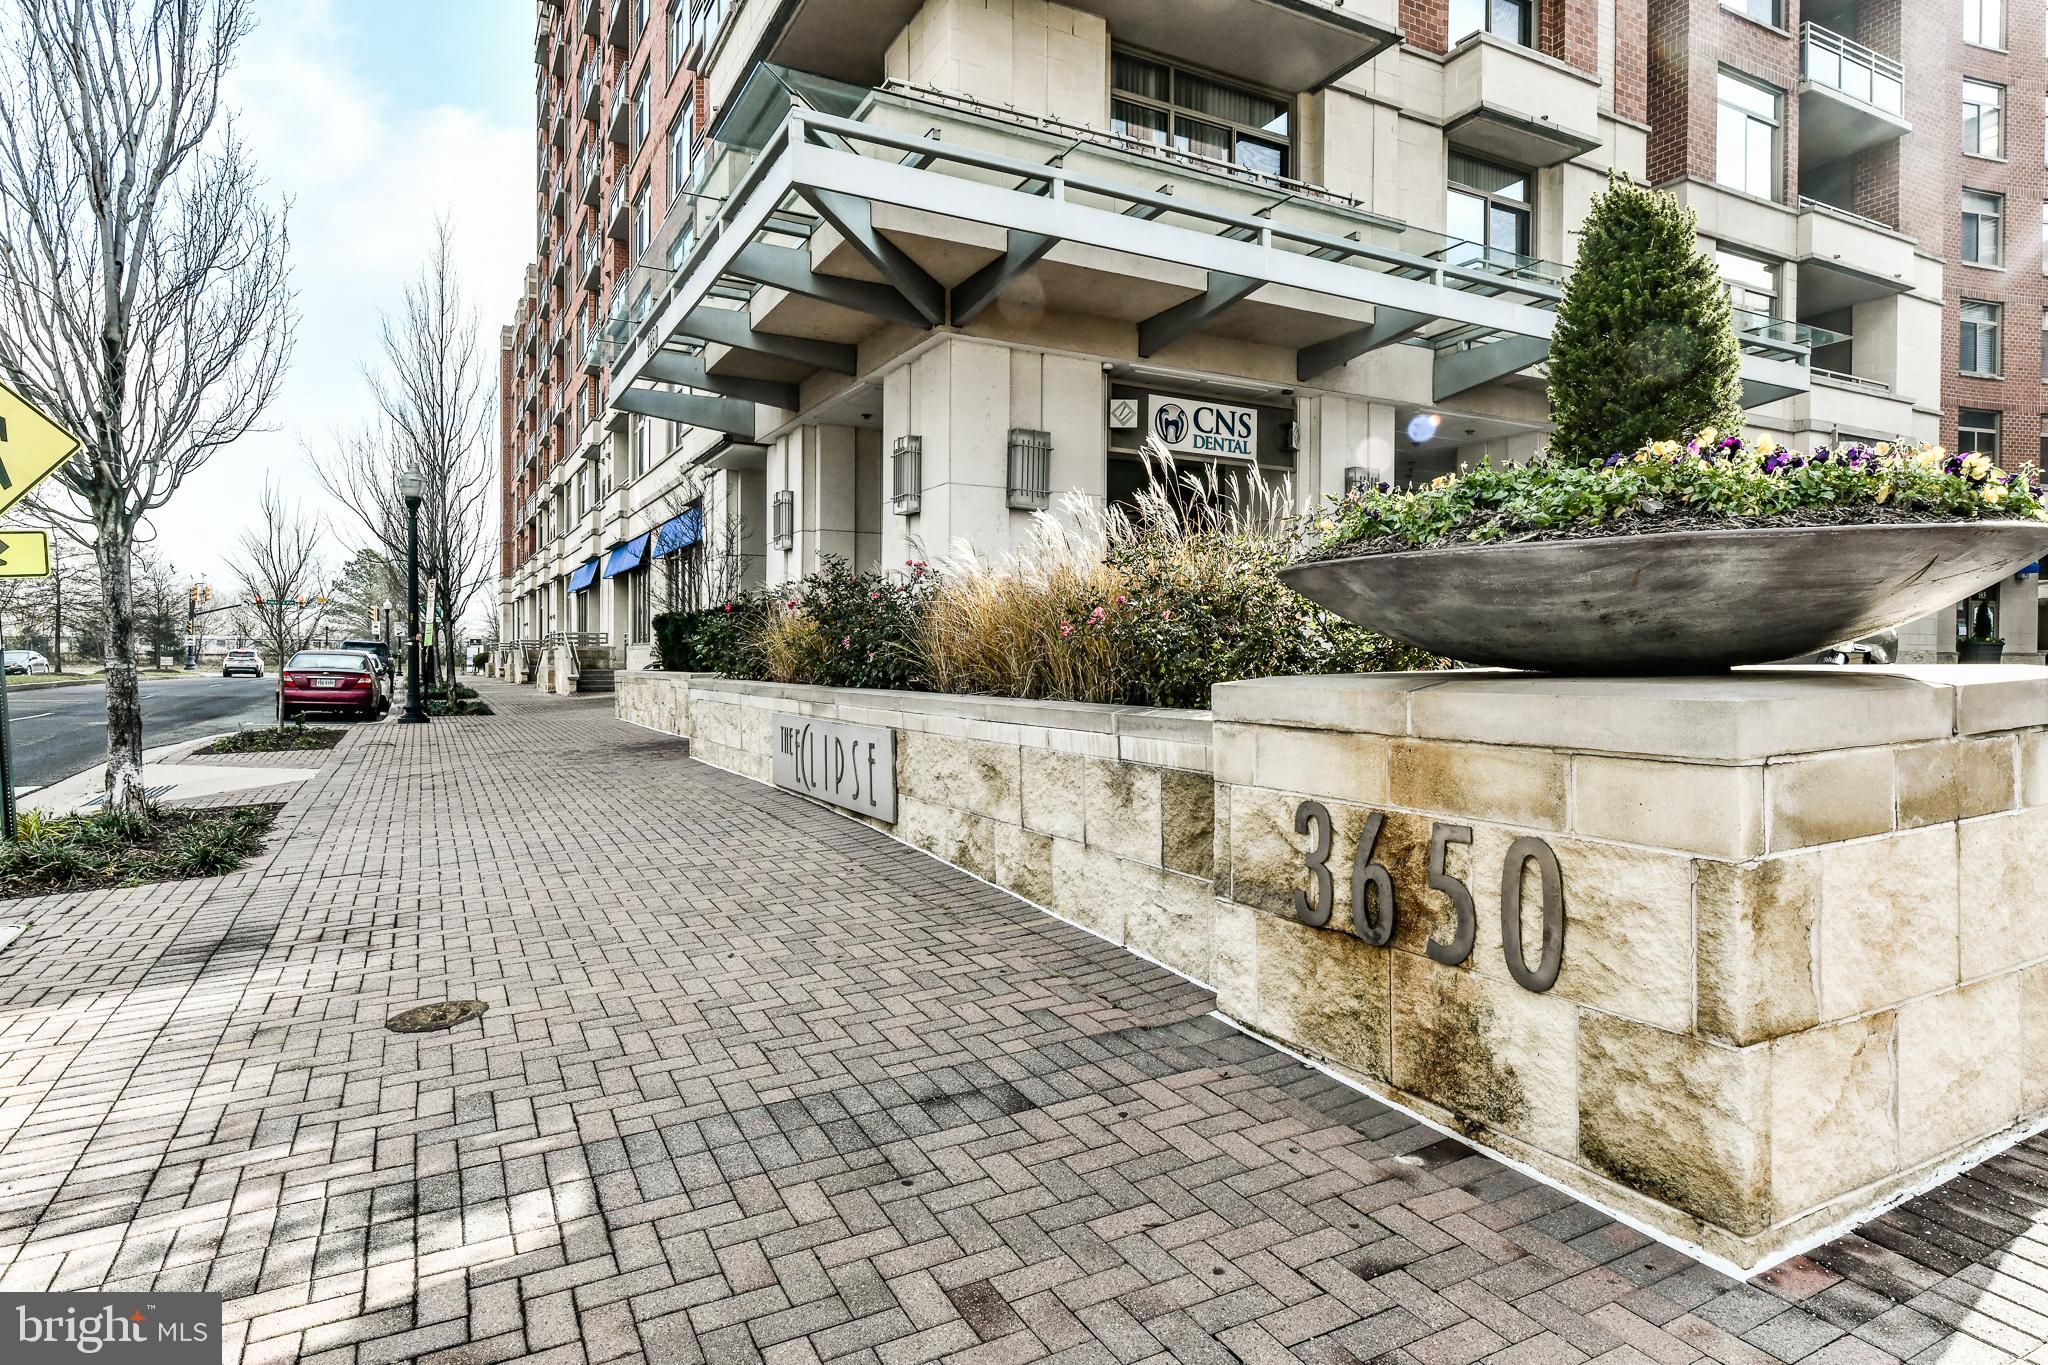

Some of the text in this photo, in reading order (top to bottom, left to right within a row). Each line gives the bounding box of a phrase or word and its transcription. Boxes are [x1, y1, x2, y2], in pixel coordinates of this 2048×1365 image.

[1193, 407, 1252, 439] CNS
[1193, 434, 1251, 455] DENTAL
[780, 723, 876, 806] THE ECLIPSE
[1294, 800, 1564, 993] 3650
